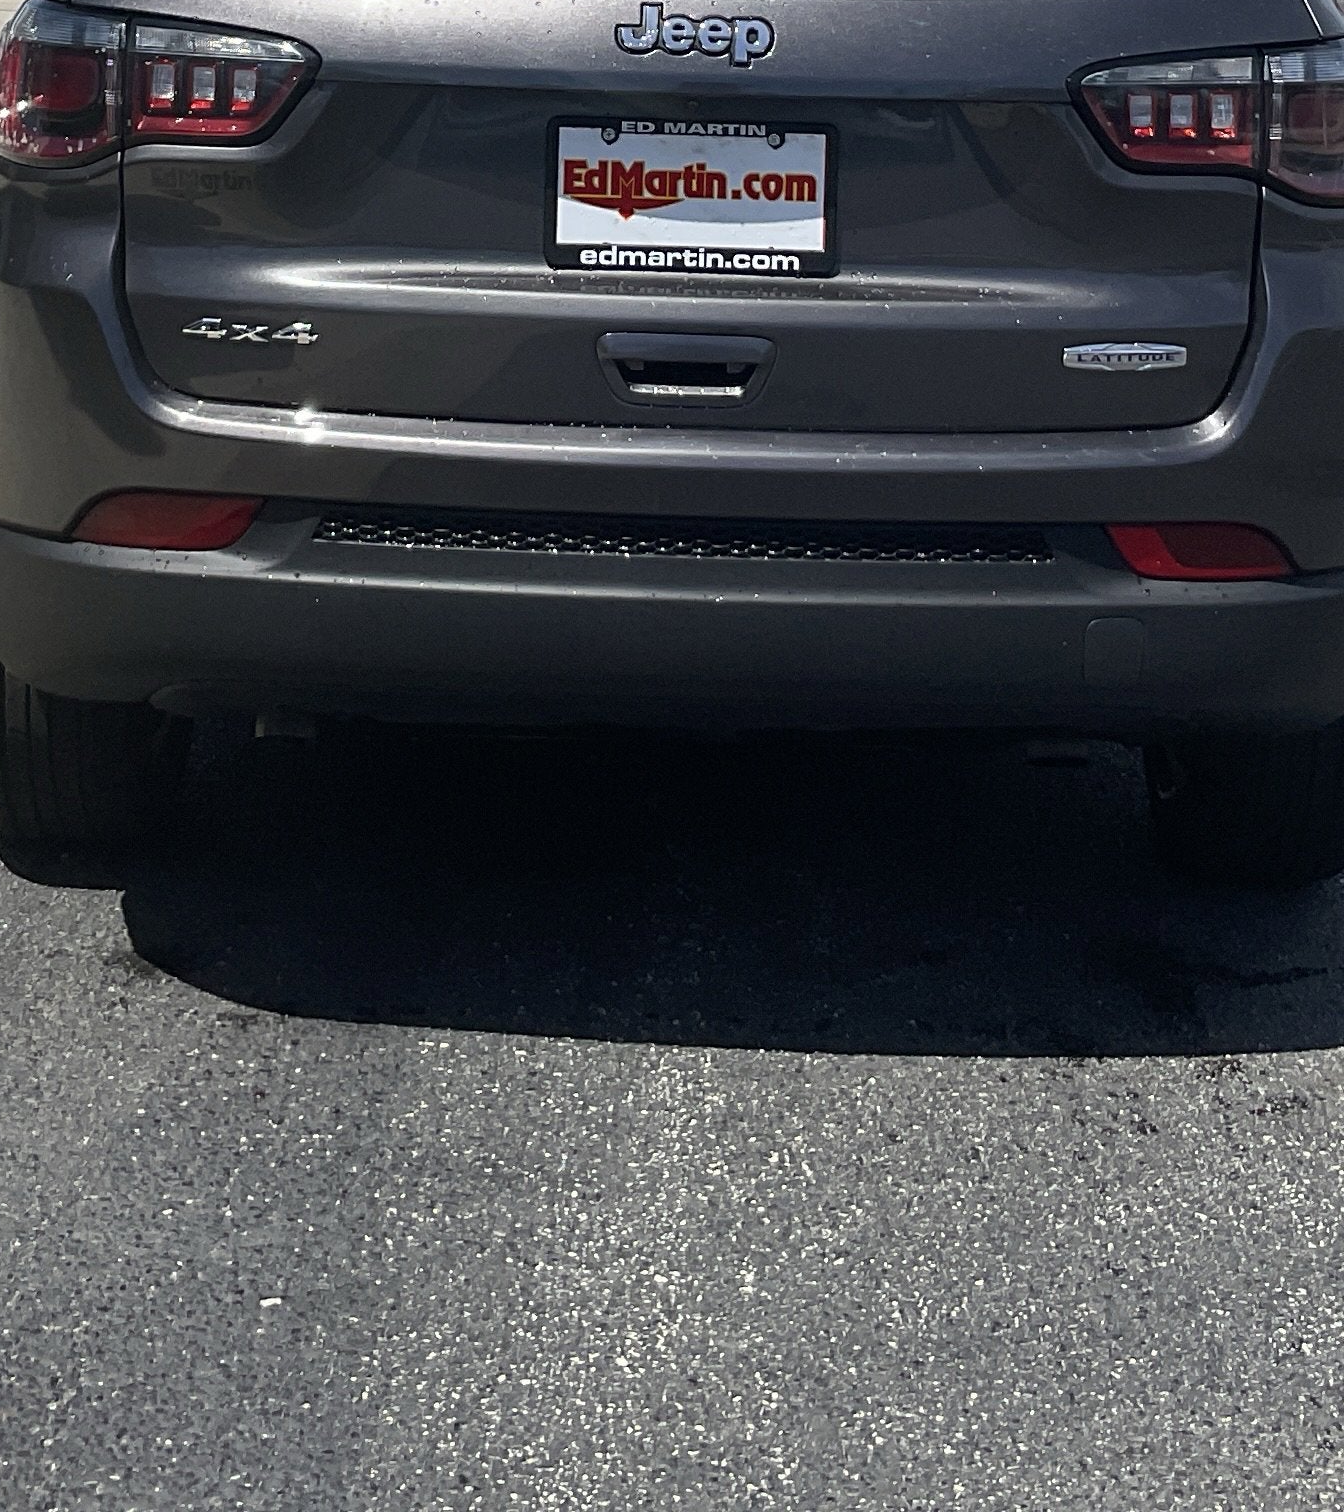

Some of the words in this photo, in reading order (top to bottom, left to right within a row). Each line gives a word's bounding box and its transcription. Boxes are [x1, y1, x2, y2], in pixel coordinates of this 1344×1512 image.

[614, 1, 775, 68] Jeep
[621, 120, 656, 134] ED
[663, 122, 767, 137] MARTIN
[563, 159, 817, 203] EdMartin.com
[579, 245, 801, 271] edmartin.com
[181, 317, 320, 345] 4x4
[1077, 353, 1176, 363] LATITUDE
